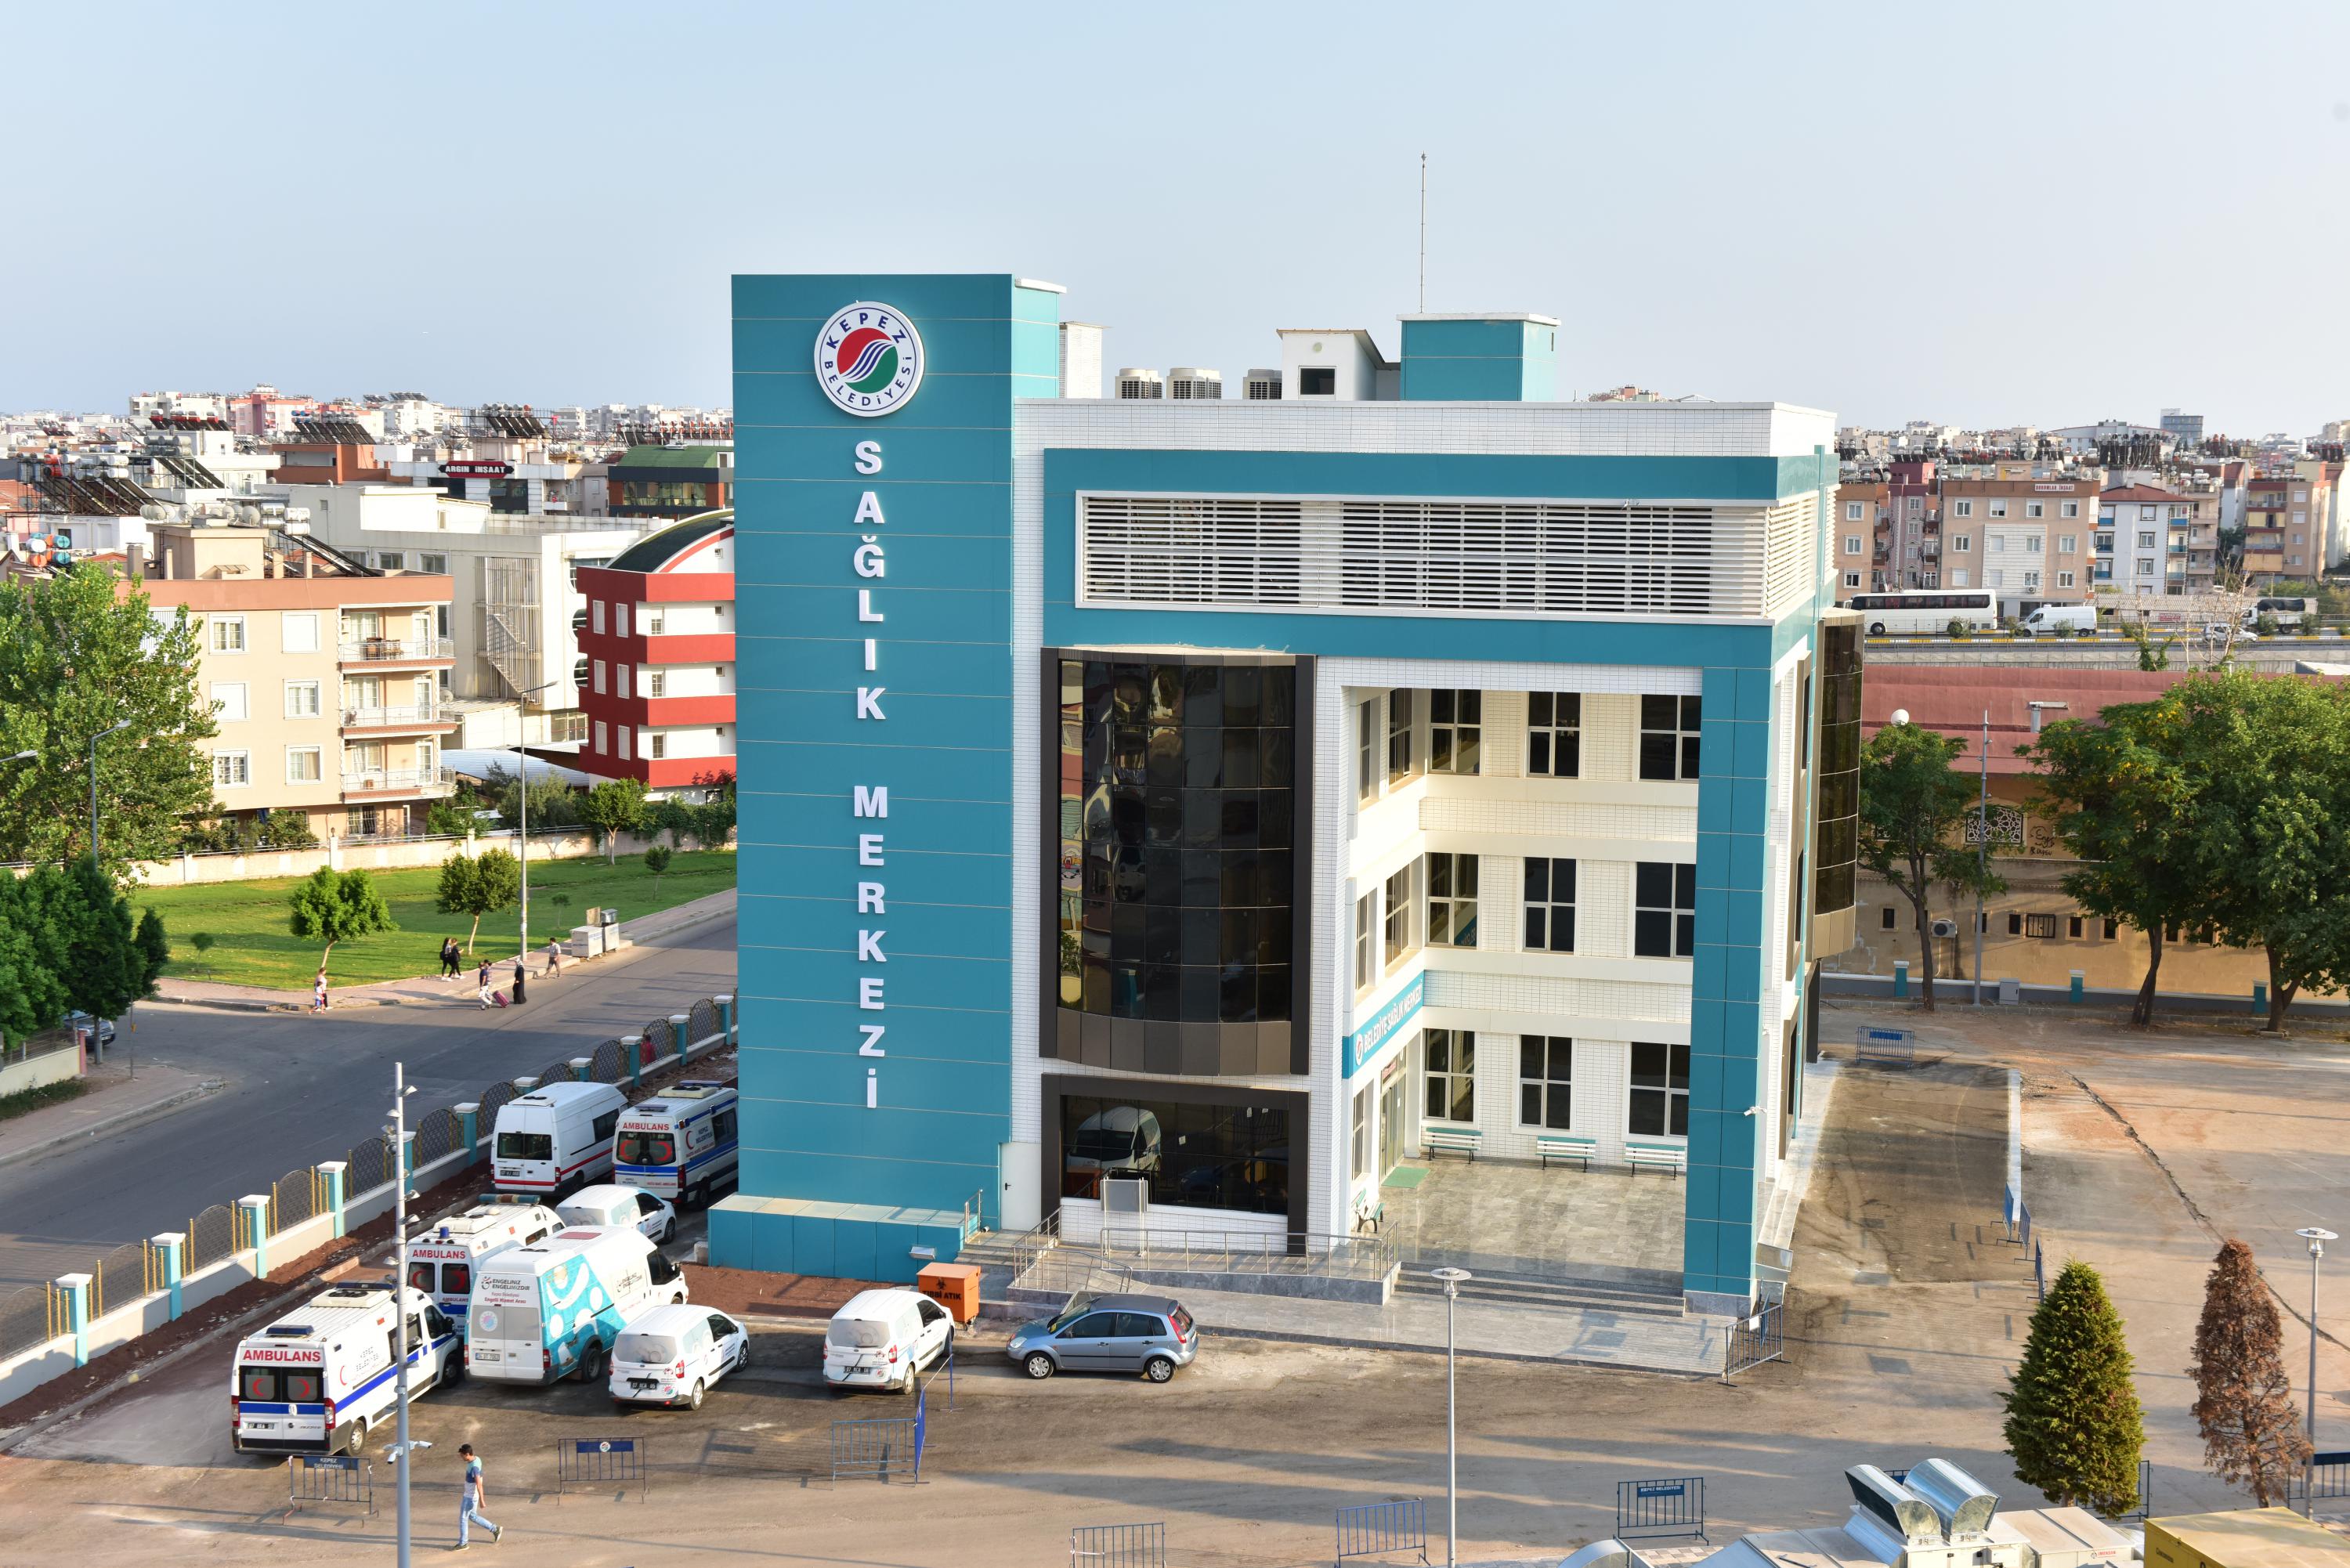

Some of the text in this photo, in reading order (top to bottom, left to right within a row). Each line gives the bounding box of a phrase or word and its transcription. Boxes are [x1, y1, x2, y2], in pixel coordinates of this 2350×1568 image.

[826, 312, 907, 350] KEPEZ
[854, 440, 888, 721] SAĞLIK
[853, 785, 888, 1109] MERKEZİ
[622, 1122, 670, 1131] AMBULANS
[412, 1249, 466, 1259] AMBULANS
[243, 1349, 321, 1363] AMBULANS
